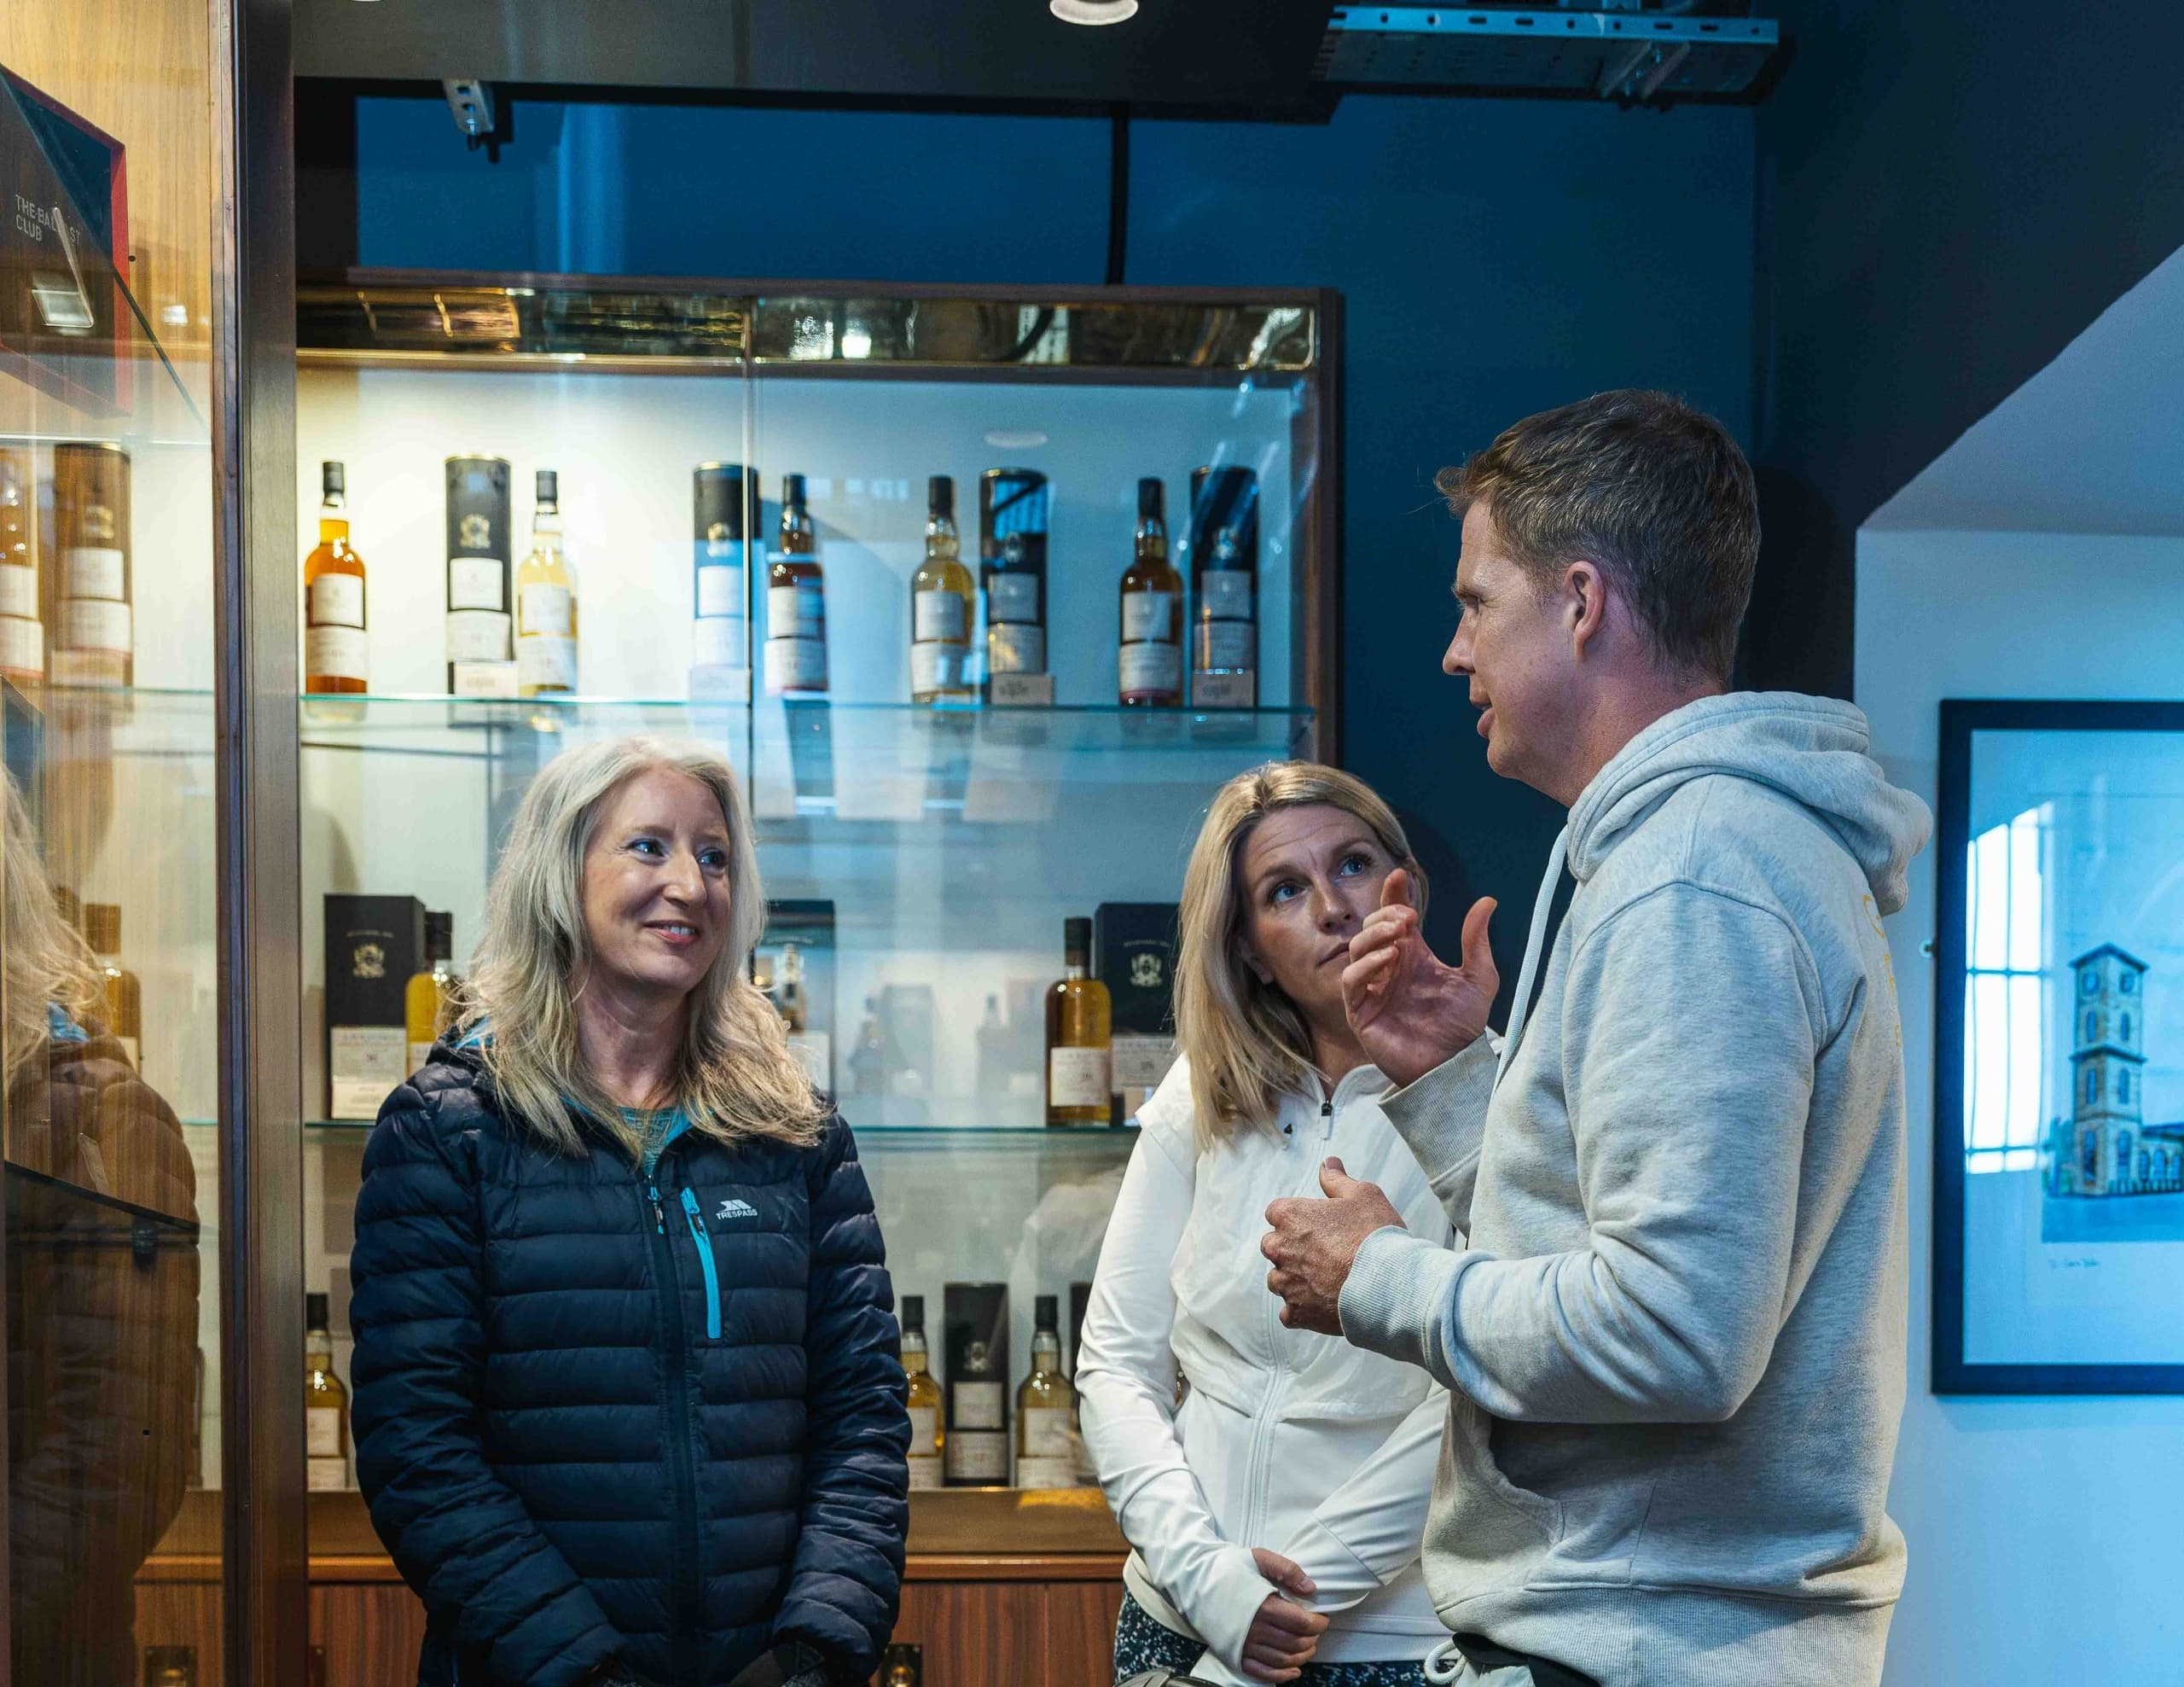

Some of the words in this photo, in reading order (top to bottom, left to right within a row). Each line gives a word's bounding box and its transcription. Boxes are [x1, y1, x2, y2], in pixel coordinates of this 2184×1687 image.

[15, 194, 35, 218] THE
[38, 207, 80, 246] BALST
[16, 213, 43, 241] CLUB
[716, 1209, 758, 1220] TRESPASS
